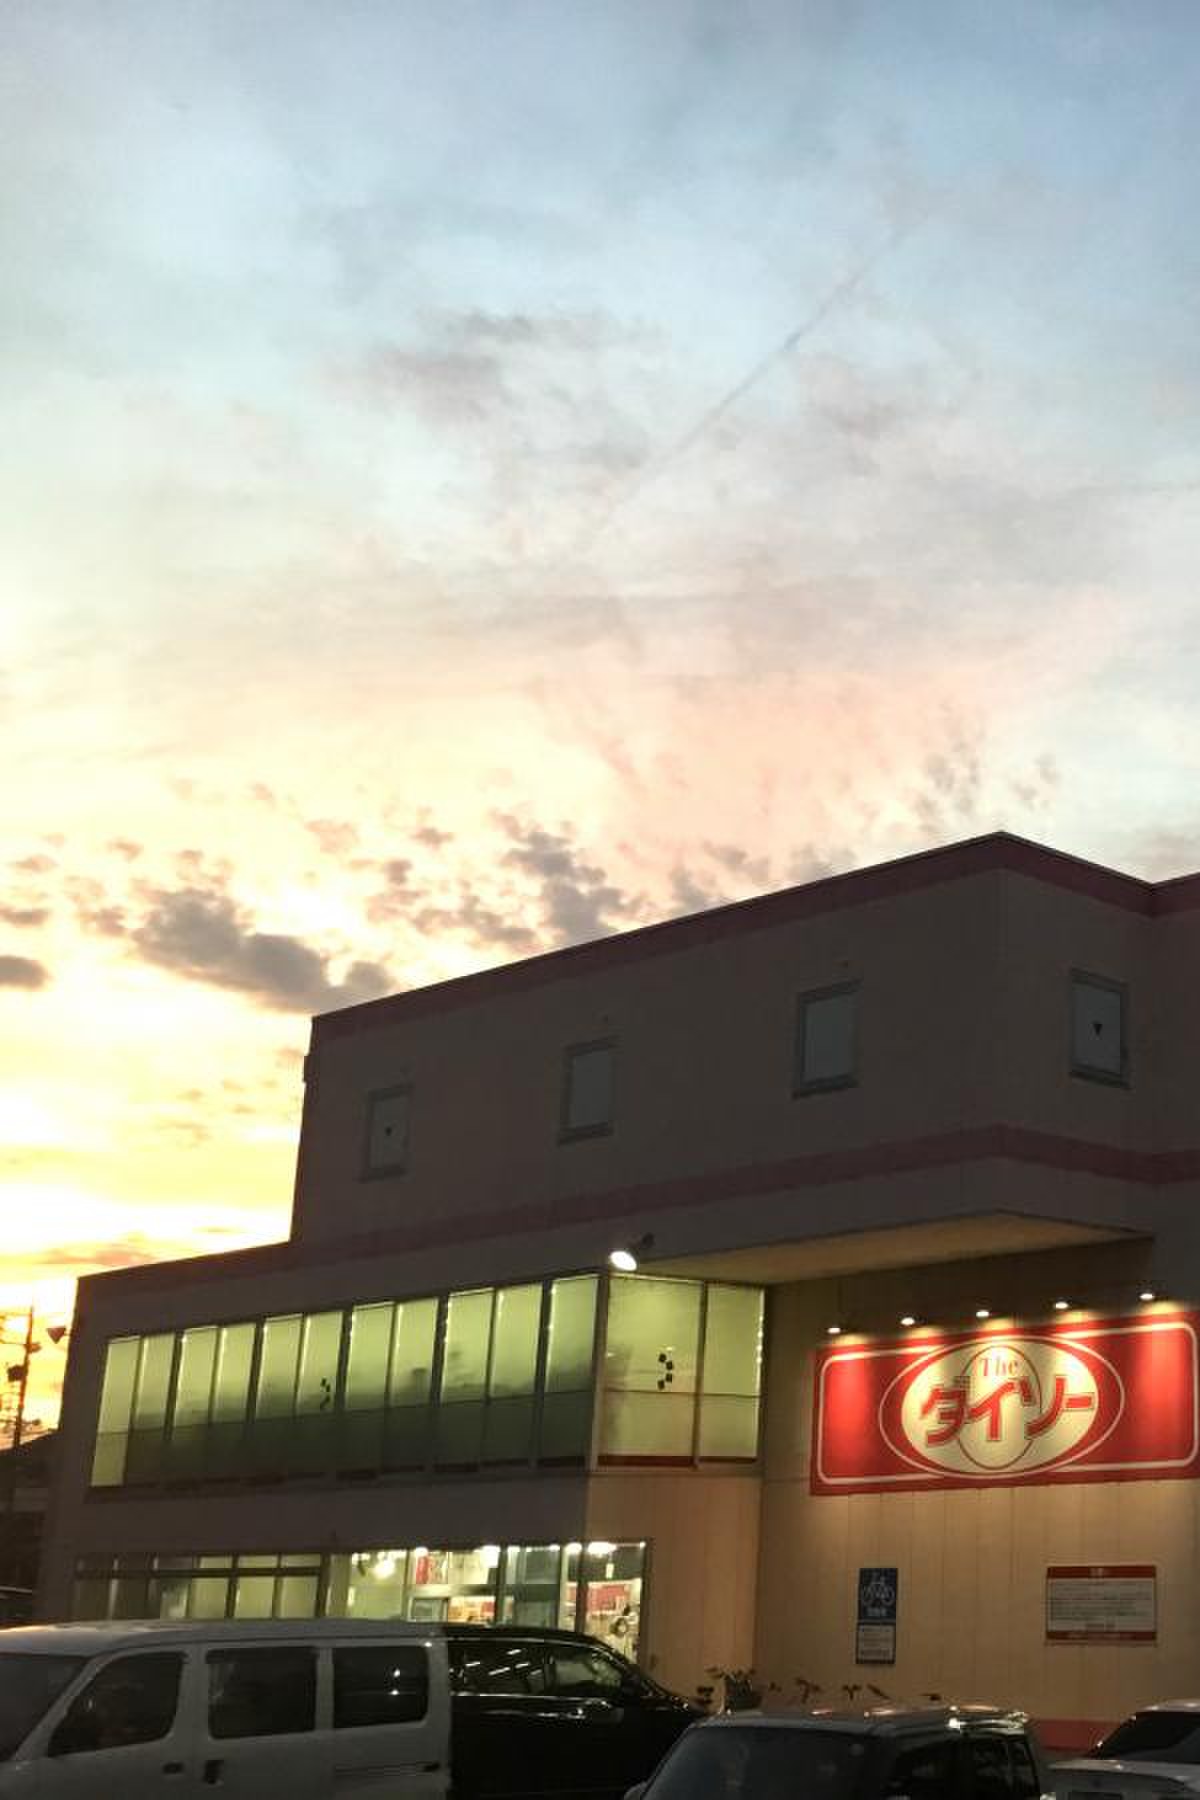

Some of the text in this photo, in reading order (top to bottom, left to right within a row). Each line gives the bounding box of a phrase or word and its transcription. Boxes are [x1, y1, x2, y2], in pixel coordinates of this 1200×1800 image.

[978, 1355, 1020, 1378] The
[919, 1374, 1096, 1448] ダイソー
